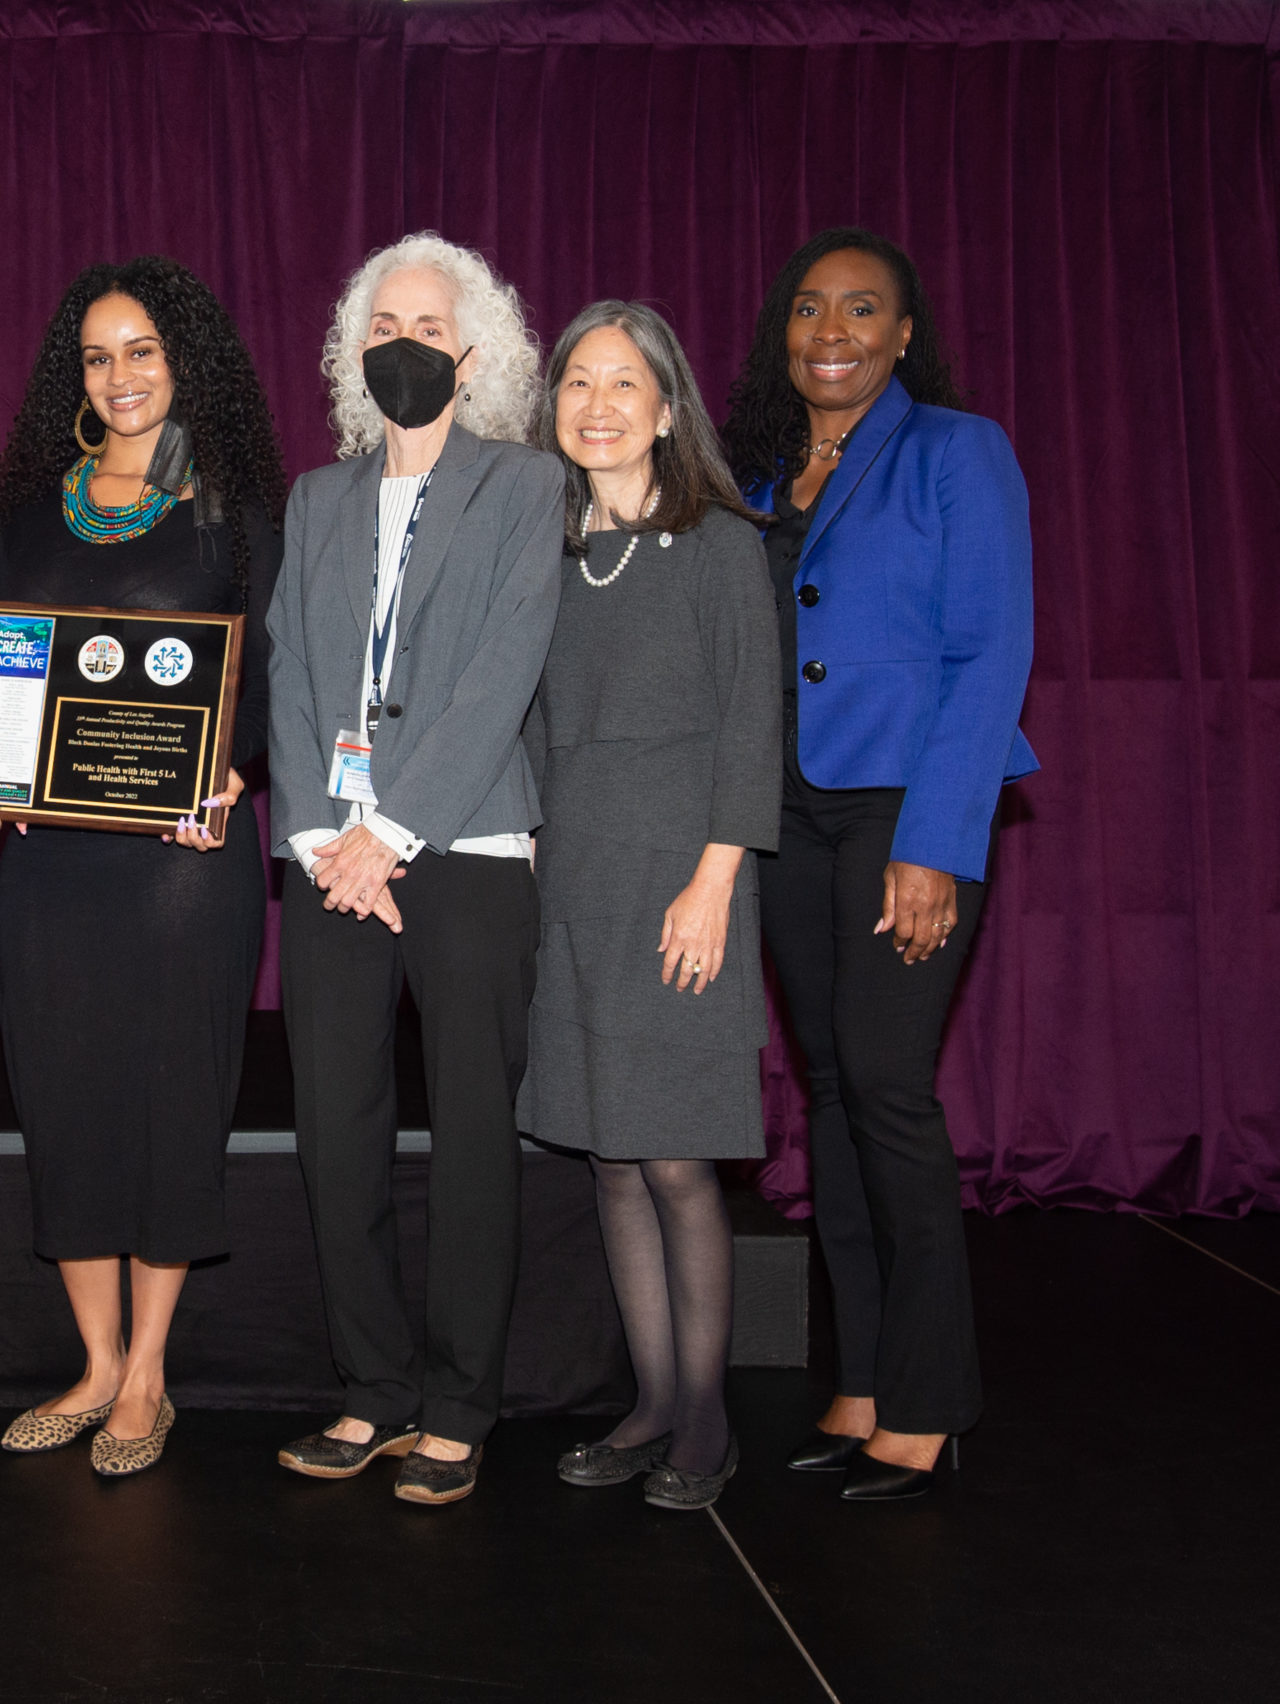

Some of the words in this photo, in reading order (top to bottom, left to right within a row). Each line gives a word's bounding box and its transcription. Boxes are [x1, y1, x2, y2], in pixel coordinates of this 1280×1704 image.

[77, 728, 120, 739] Community
[122, 732, 155, 741] Inclusion
[156, 734, 181, 743] Award
[73, 763, 95, 772] Public
[97, 765, 120, 774] Health
[122, 767, 138, 775] with
[139, 768, 156, 777] First
[165, 770, 176, 778] LA
[104, 774, 127, 783] Health
[129, 776, 158, 785] Services
